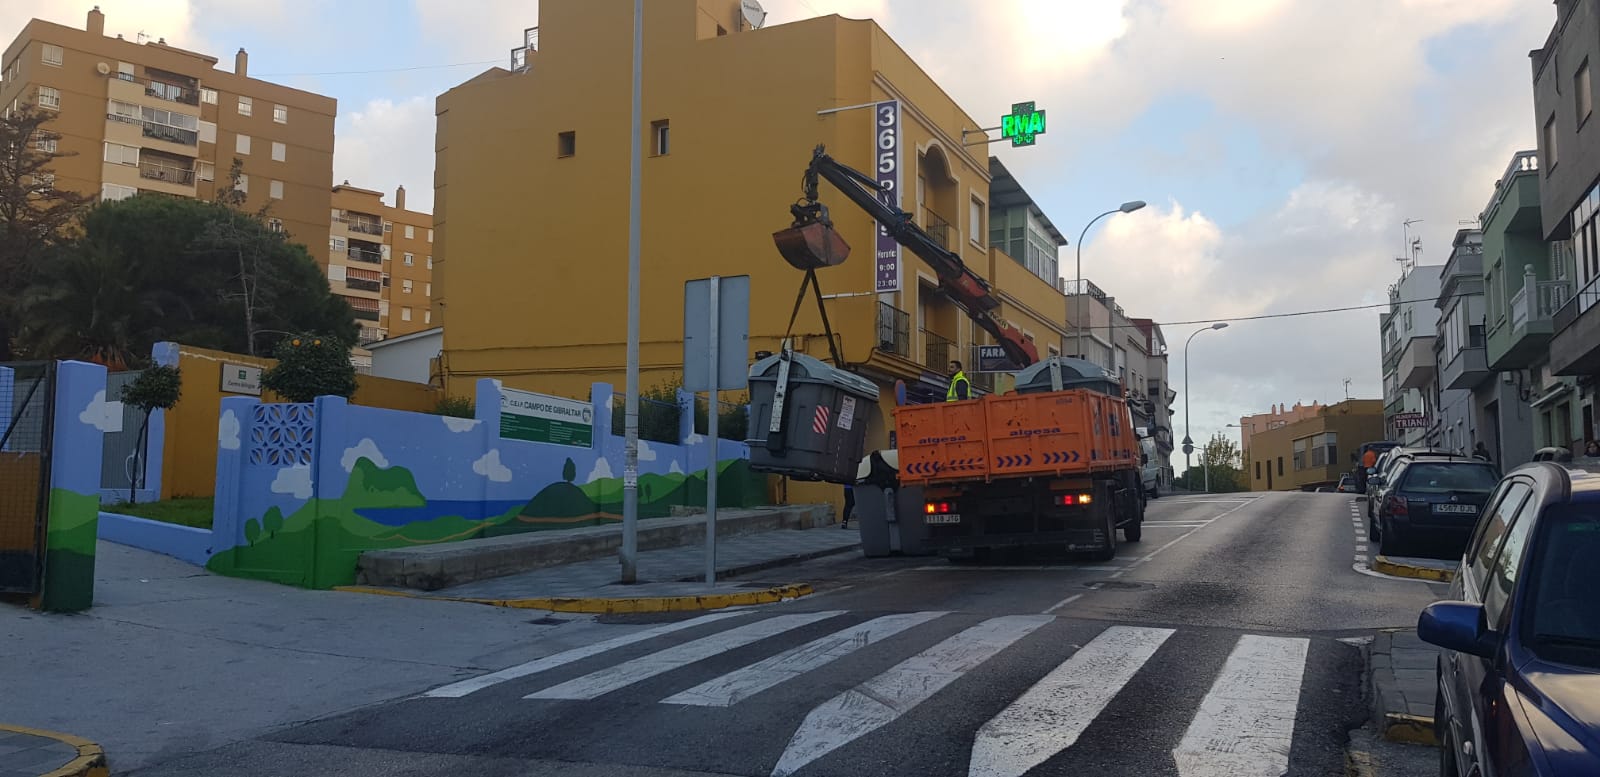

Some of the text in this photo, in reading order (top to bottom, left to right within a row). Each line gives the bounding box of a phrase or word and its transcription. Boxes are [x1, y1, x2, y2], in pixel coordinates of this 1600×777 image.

[1002, 112, 1044, 137] RMA
[524, 401, 545, 412] CAMPO
[545, 404, 552, 413] DE
[553, 406, 581, 417] GIBRALTAR
[1009, 427, 1062, 437] algesa
[918, 434, 967, 445] algesa
